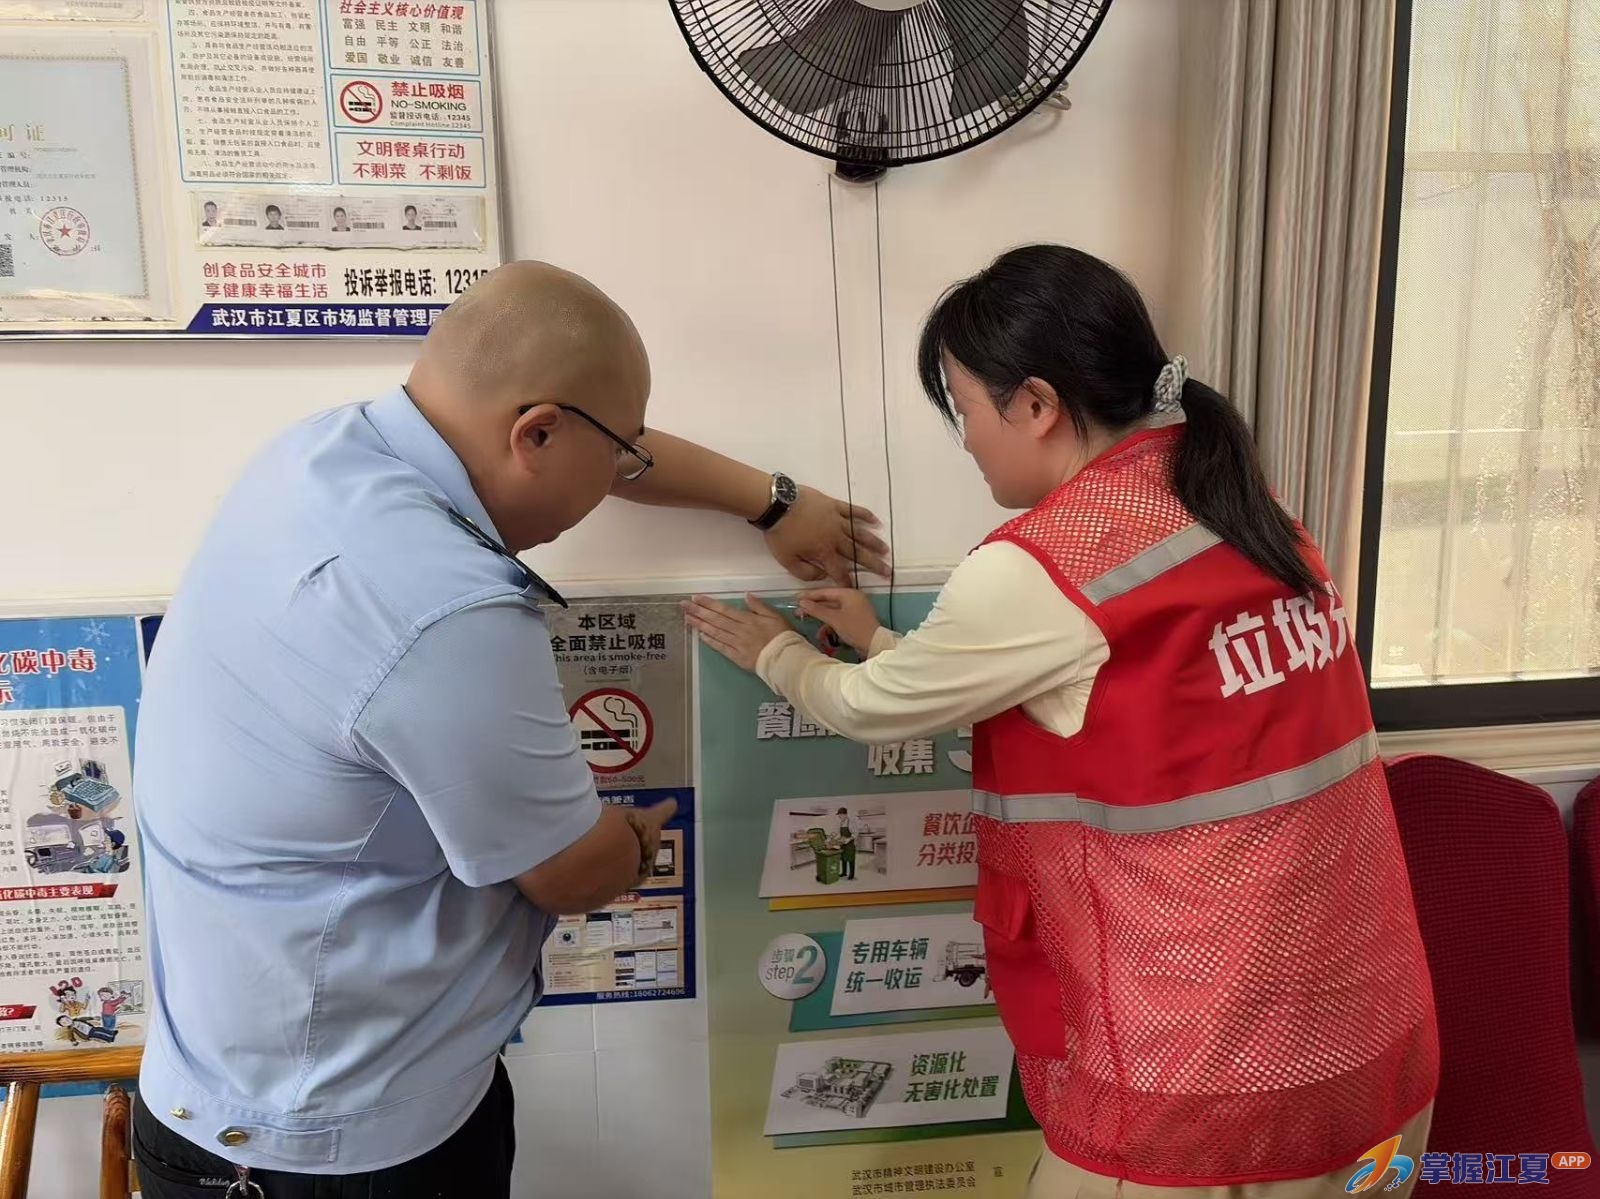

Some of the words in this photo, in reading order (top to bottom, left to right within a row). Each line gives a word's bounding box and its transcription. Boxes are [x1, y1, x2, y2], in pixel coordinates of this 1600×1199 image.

[339, 1, 465, 20] 社会主义核心价值观
[342, 18, 366, 30] 富强
[376, 20, 398, 31] 民主
[408, 22, 431, 33] 文明
[441, 23, 462, 35] 和谐
[344, 36, 366, 47] 自由
[376, 36, 399, 48] 平等
[409, 38, 432, 50] 公正
[441, 40, 464, 51] 法治
[345, 52, 368, 63] 爱国
[377, 53, 400, 65] 敬业
[410, 55, 432, 67] 诚信
[442, 57, 464, 68] 友善
[391, 81, 464, 100] 禁止吸烟
[391, 100, 467, 111] NO-SMOKING
[357, 140, 465, 159] 文明餐桌行动
[352, 162, 406, 179] 不剩菜
[419, 164, 472, 180] 不剩饭
[202, 262, 327, 279] 创食品安全城市
[205, 283, 328, 299] 享健康幸福生活
[212, 308, 440, 328] 武汉市江夏区市场监督管理局
[578, 613, 636, 631] 本区域
[550, 633, 665, 652] 全面禁止吸烟
[573, 653, 595, 661] area
[598, 653, 607, 661] is
[867, 738, 935, 777] 收集
[771, 948, 795, 964] 步骤
[852, 937, 929, 965] 专用车辆
[765, 965, 795, 981] step
[793, 945, 818, 985] 2
[845, 967, 923, 993] 统一收运
[911, 1051, 967, 1077] 资源化
[904, 1075, 999, 1103] 无害化处置
[851, 1161, 976, 1181] 武汉市精神文明建设办公室
[852, 1176, 976, 1196] 武汉市城市管理执法委员会
